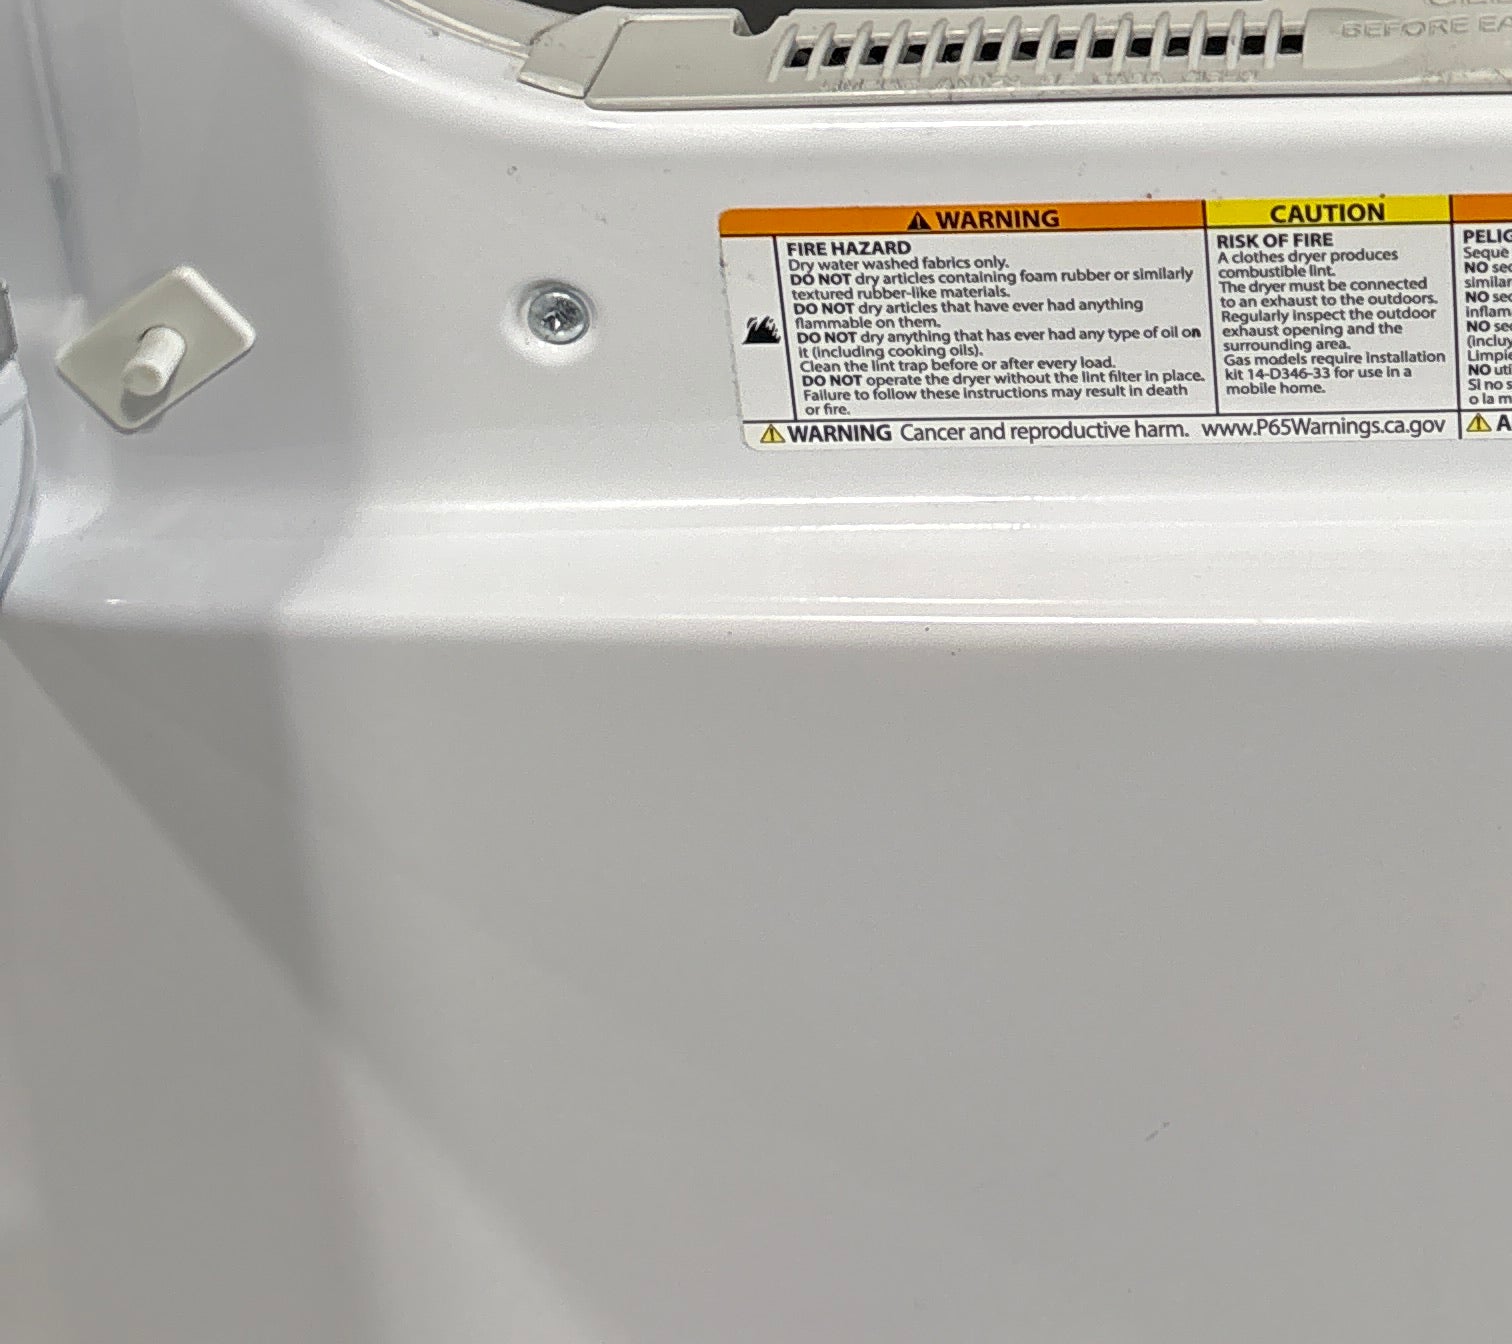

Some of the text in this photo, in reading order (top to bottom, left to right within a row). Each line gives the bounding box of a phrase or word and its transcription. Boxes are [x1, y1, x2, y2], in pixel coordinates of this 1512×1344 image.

[1341, 16, 1469, 39] BEFORE
[936, 209, 1060, 229] WARNING
[1270, 202, 1385, 223] CAUTION
[786, 241, 912, 256] FIRE HAZARD
[1216, 234, 1333, 249] RISK OF FIRE
[1217, 248, 1399, 266] A clothes dryer produces
[1463, 245, 1509, 262] Seque
[787, 255, 1009, 275] Dry water washed fabrics only.
[1217, 264, 1335, 279] combustible lint.
[1463, 261, 1488, 274] NO
[789, 267, 1194, 288] DO NOT dry articles containing foam rubber or similarly
[1218, 277, 1428, 296] The dryer must be connected
[791, 285, 1010, 301] textured rubber-like materials.
[792, 297, 1144, 318] DO NOT dry articles that have ever had anything
[1224, 365, 1412, 380] kit 14-D346-33 for use in a
[1225, 381, 1325, 395] mobile home.
[787, 419, 1190, 444] WARNING Cancer and reproductive harm.
[1201, 417, 1446, 439] www.P65Warnings.ca.gov
